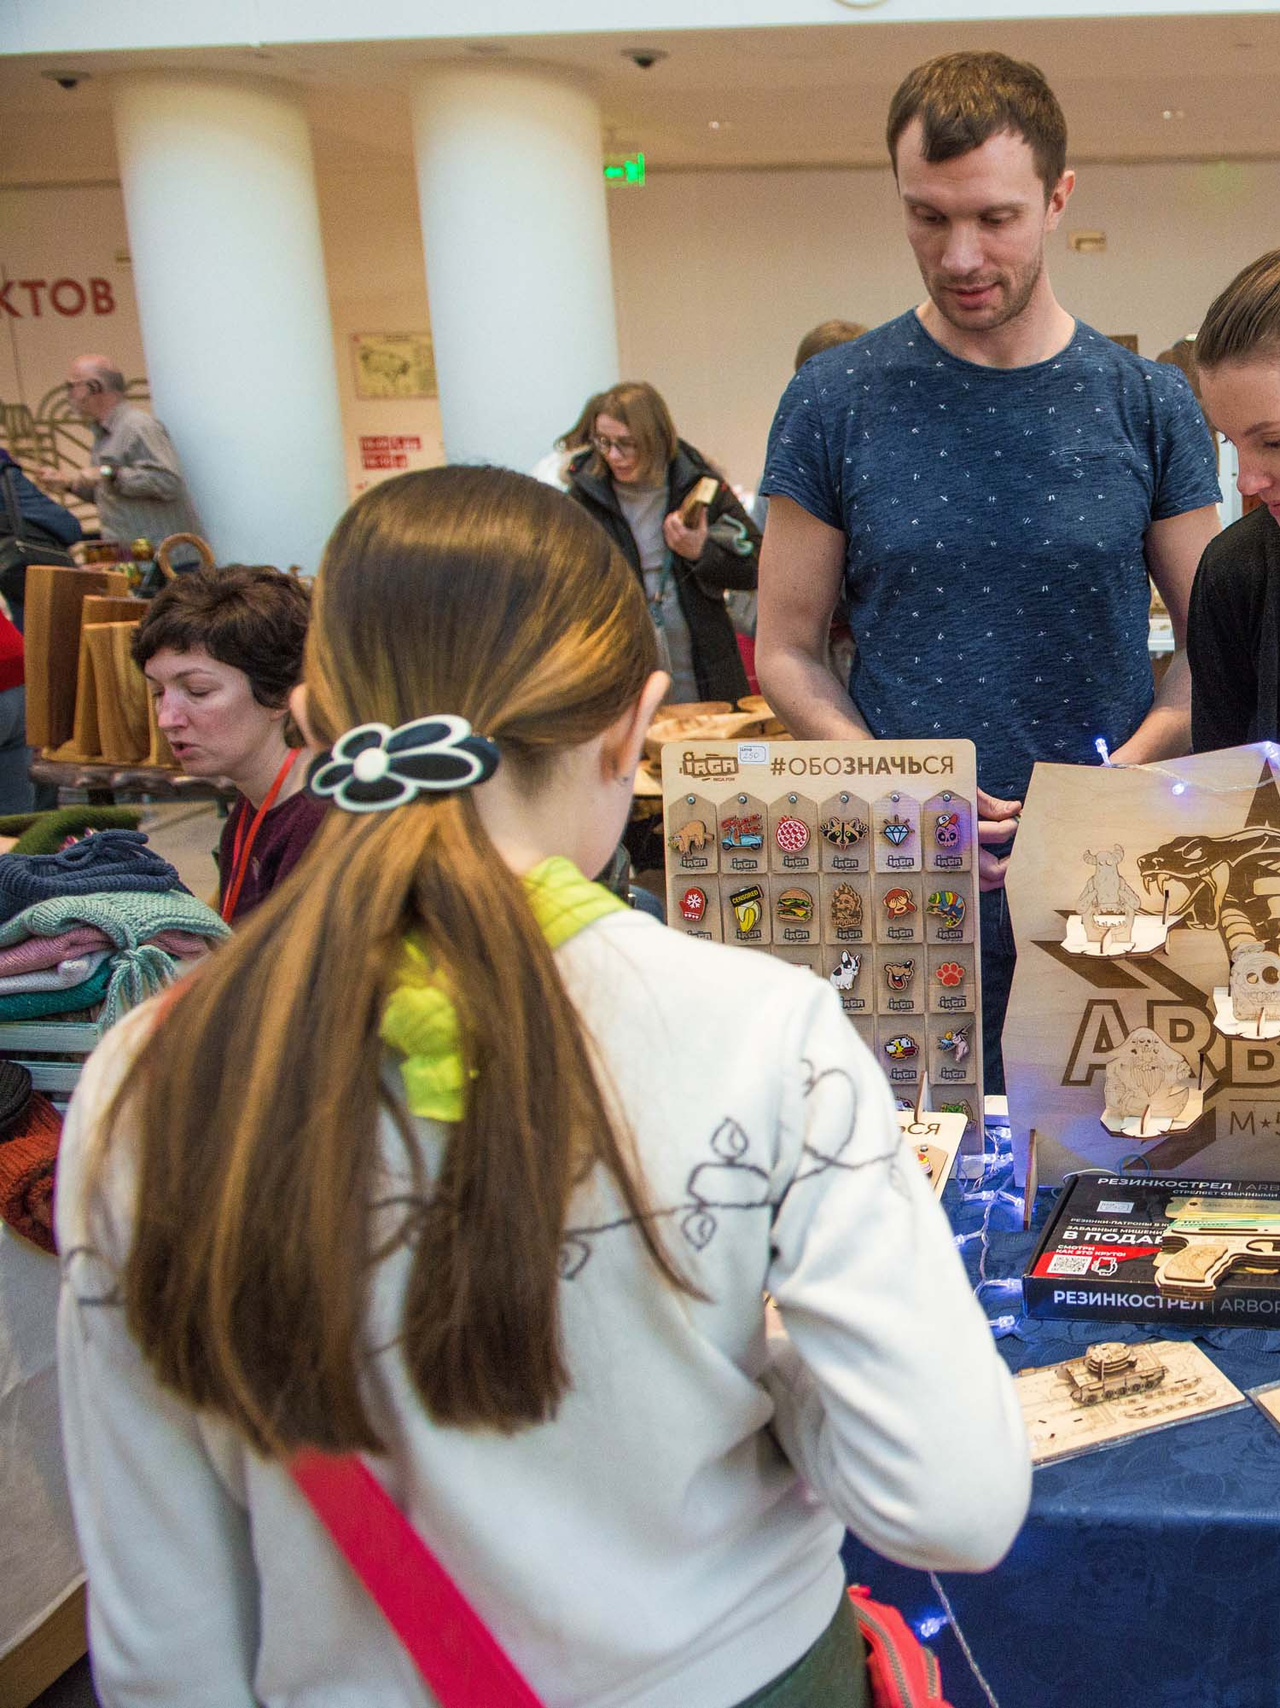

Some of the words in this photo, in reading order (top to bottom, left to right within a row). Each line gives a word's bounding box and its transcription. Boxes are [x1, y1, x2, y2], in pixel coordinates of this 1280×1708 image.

[771, 756, 954, 776] #ОБОЗНАЧЬСЯ
[731, 889, 759, 904] CENSORED
[1097, 1178, 1232, 1190] РЕЗИНКОСТРЕЛ
[1062, 1231, 1078, 1240] В
[1067, 1225, 1118, 1233] ЗАБАВНЫЕ
[1053, 1289, 1205, 1311] РЕЗИНКОСТРЕЛ
